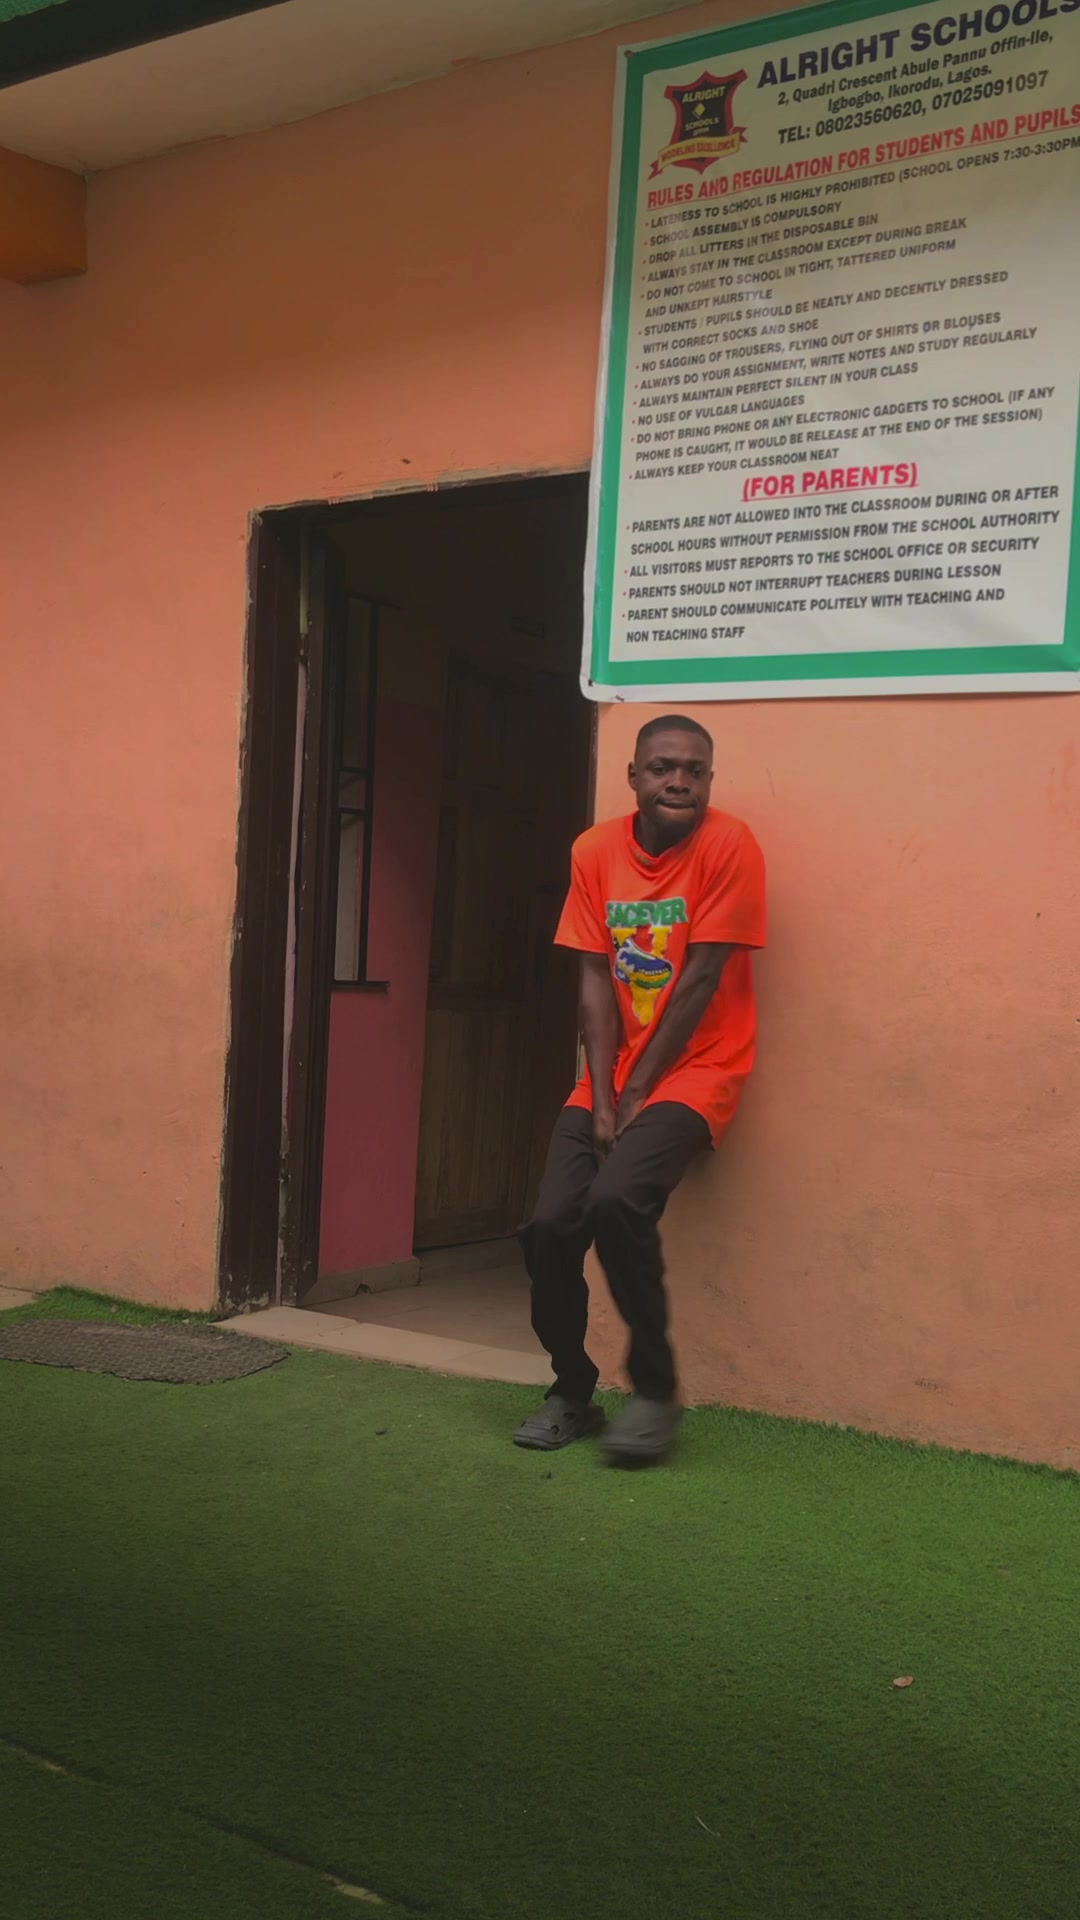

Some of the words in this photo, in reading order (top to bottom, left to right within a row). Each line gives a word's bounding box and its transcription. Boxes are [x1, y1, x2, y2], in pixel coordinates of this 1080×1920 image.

[758, 30, 900, 88] ALRIGHT
[777, 92, 789, 105] 2,
[792, 80, 835, 102] Quadri
[838, 67, 897, 91] Crescent
[900, 58, 939, 77] Abule
[942, 48, 987, 67] Pannu
[682, 86, 726, 104] ALRIGHT
[778, 126, 810, 144] TEL:
[815, 99, 926, 136] 08023560620,
[932, 70, 1048, 110] 07025091097
[828, 91, 883, 113] Igbogbo,
[888, 76, 943, 98] Ikorodu,
[947, 65, 992, 84] Lagos.
[647, 184, 694, 208] RULES
[698, 176, 729, 198] AND
[732, 155, 833, 190] REGULATION
[837, 148, 870, 170] FOR
[875, 127, 964, 162] STUDENTS
[969, 119, 1008, 145] AND
[1014, 104, 1080, 138] PUPILS
[650, 209, 701, 228] LATENESS
[704, 207, 720, 217] TO
[722, 197, 762, 215] SCHOOL
[765, 194, 777, 204] IS
[779, 186, 822, 202] HIGHLY
[825, 172, 895, 194] PROHIBITED
[898, 161, 952, 182] (SCHOOL
[956, 152, 999, 169] OPENS
[649, 230, 688, 246] SCHOOL
[692, 219, 749, 237] ASSEMBLY
[751, 216, 761, 227] IS
[763, 202, 841, 224] COMPULSORY
[645, 306, 666, 318] AND
[668, 298, 710, 314] UNKEPT
[712, 289, 773, 306] HAIRSTYLE
[640, 375, 680, 389] ALWAYS
[683, 373, 699, 384] DO
[701, 368, 730, 381] YOUR
[732, 359, 806, 377] ASSIGNMENT,
[810, 353, 845, 367] WRITE
[848, 347, 886, 362] NOTES
[889, 343, 915, 356] AND
[918, 338, 958, 352] STUDY
[962, 328, 1037, 346] REGULARLY
[641, 361, 656, 372] NO
[659, 354, 706, 369] SAGGING
[708, 351, 722, 362] OF
[725, 343, 785, 359] TROUSERS,
[788, 337, 828, 351] FLYING
[830, 332, 854, 345] OUT
[856, 330, 873, 341] OF
[875, 323, 919, 338] SHIRTS
[922, 320, 940, 333] OR
[943, 312, 1001, 331] BLOUSES
[638, 393, 679, 407] ALWAYS
[681, 386, 733, 402] MAINTAIN
[735, 379, 782, 394] PERFECT
[785, 375, 827, 388] SILENT
[829, 373, 842, 384] IN
[845, 368, 877, 382] YOUR
[880, 362, 918, 377] CLASS
[636, 433, 652, 443] DO
[654, 430, 675, 441] NOT
[677, 426, 711, 439] BRING
[713, 421, 751, 434] PHONE
[753, 419, 769, 430] OR
[771, 416, 793, 428] ANY
[795, 408, 870, 424] ELECTRONIC
[872, 400, 928, 416] GADGETS
[932, 398, 949, 409] TO
[952, 392, 1003, 407] SCHOOL
[1008, 390, 1025, 403] (IF
[1027, 387, 1055, 399] ANY
[637, 415, 653, 425] NO
[655, 412, 676, 424] USE
[678, 410, 692, 420] OF
[695, 404, 738, 418] VULGAR
[740, 395, 805, 413] LANGUAGES
[635, 448, 671, 461] PHONE
[673, 447, 683, 457] IS
[686, 442, 731, 456] CAUGHT,
[734, 440, 745, 450] IT
[747, 435, 787, 449] WOULD
[789, 433, 803, 444] BE
[806, 428, 858, 441] RELEASE
[861, 426, 876, 437] AT
[879, 423, 902, 435] THE
[905, 420, 931, 432] END
[934, 418, 951, 429] OF
[954, 415, 978, 427] THE
[982, 408, 1042, 424] SESSION)
[634, 466, 674, 480] ALWAYS
[677, 463, 705, 475] KEEP
[707, 460, 737, 472] YOUR
[739, 452, 807, 468] CLASSROOM
[809, 448, 838, 460] NEAT
[743, 475, 795, 502] (FOR
[802, 463, 917, 492] PARENTS)
[632, 518, 680, 532] PARENTS
[683, 516, 705, 528] ARE
[708, 513, 732, 526] NOT
[734, 508, 790, 523] ALLOWED
[793, 505, 821, 519] INTO
[825, 503, 847, 515] THE
[850, 496, 932, 513] CLASSROOM
[935, 492, 987, 507] DURING
[991, 490, 1011, 502] OR
[1014, 486, 1059, 500] AFTER
[631, 541, 673, 555] SCHOOL
[677, 538, 716, 551] HOURS
[719, 533, 772, 547] WITHOUT
[775, 526, 850, 543] PERMISSION
[853, 523, 888, 537] FROM
[892, 521, 917, 533] THE
[921, 517, 975, 532] SCHOOL
[980, 511, 1060, 528] AUTHORITY
[629, 566, 647, 576] ALL
[651, 561, 702, 575] VISITORS
[705, 558, 736, 571] MUST
[740, 554, 794, 569] REPORTS
[797, 553, 813, 564] TO
[817, 551, 840, 563] THE
[843, 547, 893, 562] SCHOOL
[896, 543, 943, 557] OFFICE
[947, 542, 967, 554] OR
[970, 537, 1039, 553] SECURITY
[628, 585, 676, 598] PARENTS
[679, 582, 726, 595] SHOULD
[728, 580, 752, 592] NOT
[755, 576, 822, 590] INTERRUPT
[826, 571, 890, 586] TEACHERS
[894, 567, 943, 582] DURING
[947, 564, 1001, 578] LESSON
[627, 608, 668, 620] PARENT
[671, 605, 717, 618] SHOULD
[720, 600, 806, 616] COMMUNICATE
[809, 596, 868, 610] POLITELY
[870, 594, 903, 607] WITH
[906, 590, 972, 605] TEACHING
[975, 588, 1005, 601] AND
[626, 631, 649, 642] NON
[652, 628, 708, 641] TEACHING
[711, 626, 745, 638] STAFF
